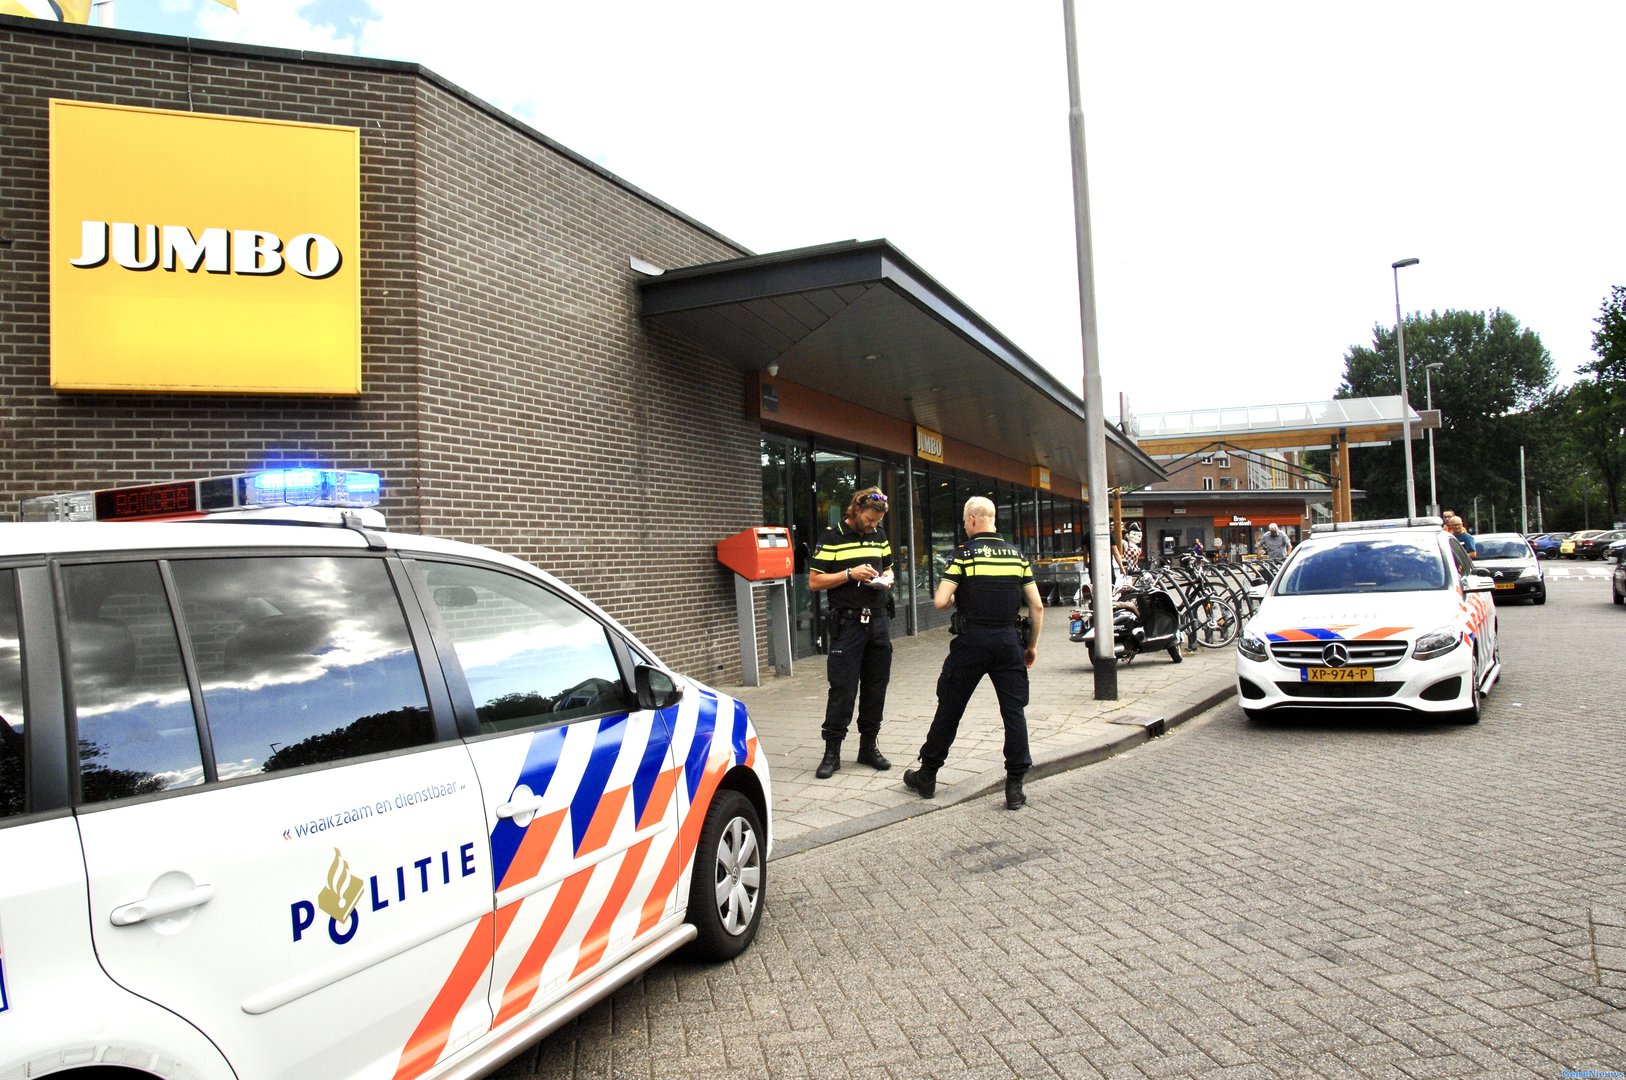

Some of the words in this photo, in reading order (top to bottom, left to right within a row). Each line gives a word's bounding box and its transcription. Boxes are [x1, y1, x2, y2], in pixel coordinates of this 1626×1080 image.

[69, 220, 343, 280] JUMBO
[917, 431, 942, 457] JUMBO
[1311, 669, 1368, 680] XP-974-P
[294, 805, 373, 838] waakzaam
[375, 800, 392, 814] en
[395, 781, 457, 809] dienstbaar
[290, 842, 476, 945] POLITIE
